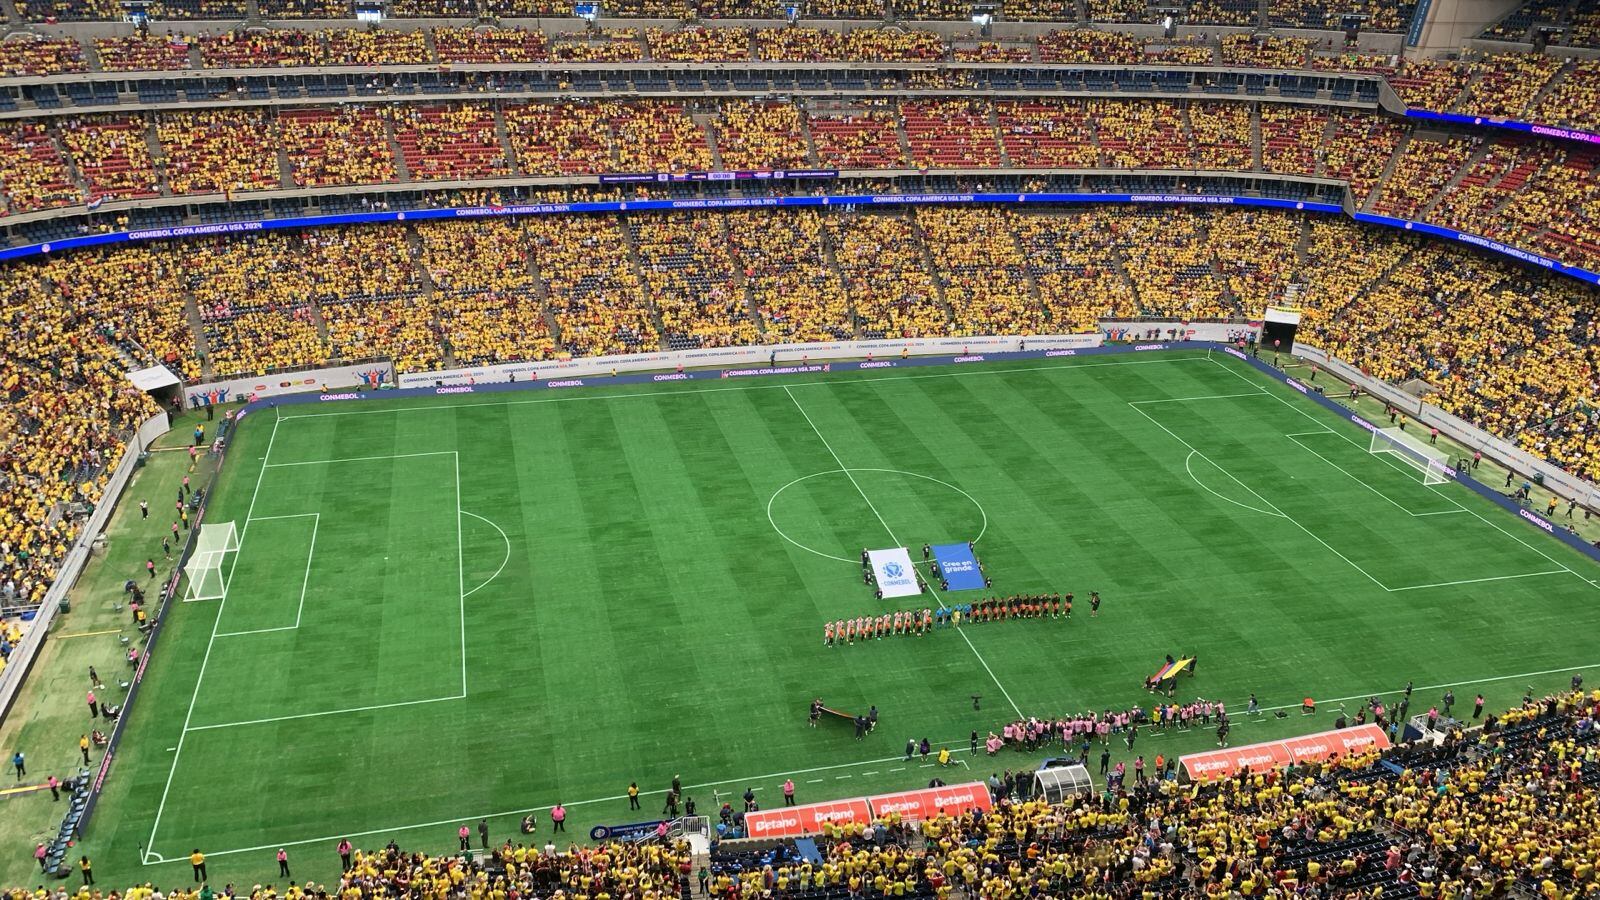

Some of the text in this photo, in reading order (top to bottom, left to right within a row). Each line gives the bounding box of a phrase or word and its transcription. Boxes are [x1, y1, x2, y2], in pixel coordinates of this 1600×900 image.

[1532, 126, 1570, 138] CONMEBOL
[1570, 132, 1590, 142] COPA
[456, 208, 493, 216] CONMEBOL
[128, 228, 172, 240] CONMEBOL
[174, 227, 194, 236] COPA
[194, 224, 228, 234] AMERICA
[1458, 234, 1554, 268] CONMEBOL COPA AMERICA USA 2024
[1224, 346, 1248, 360] CONMEBOL
[548, 380, 584, 388] CONMEBOL
[654, 374, 687, 382] CONMEBOL
[1286, 378, 1308, 394] CONMEBOL
[320, 393, 359, 401] CONMEBOL
[1520, 509, 1554, 532] CONMEBOL
[884, 578, 911, 586] CONMEBOL
[1343, 736, 1376, 748] Betano
[1294, 744, 1328, 756] Betano
[1194, 760, 1229, 772] Betano
[1238, 755, 1272, 766] Betano
[934, 794, 974, 807] Betano
[880, 801, 920, 814] Betano
[814, 810, 854, 822] Betano
[756, 818, 796, 832] Betano
